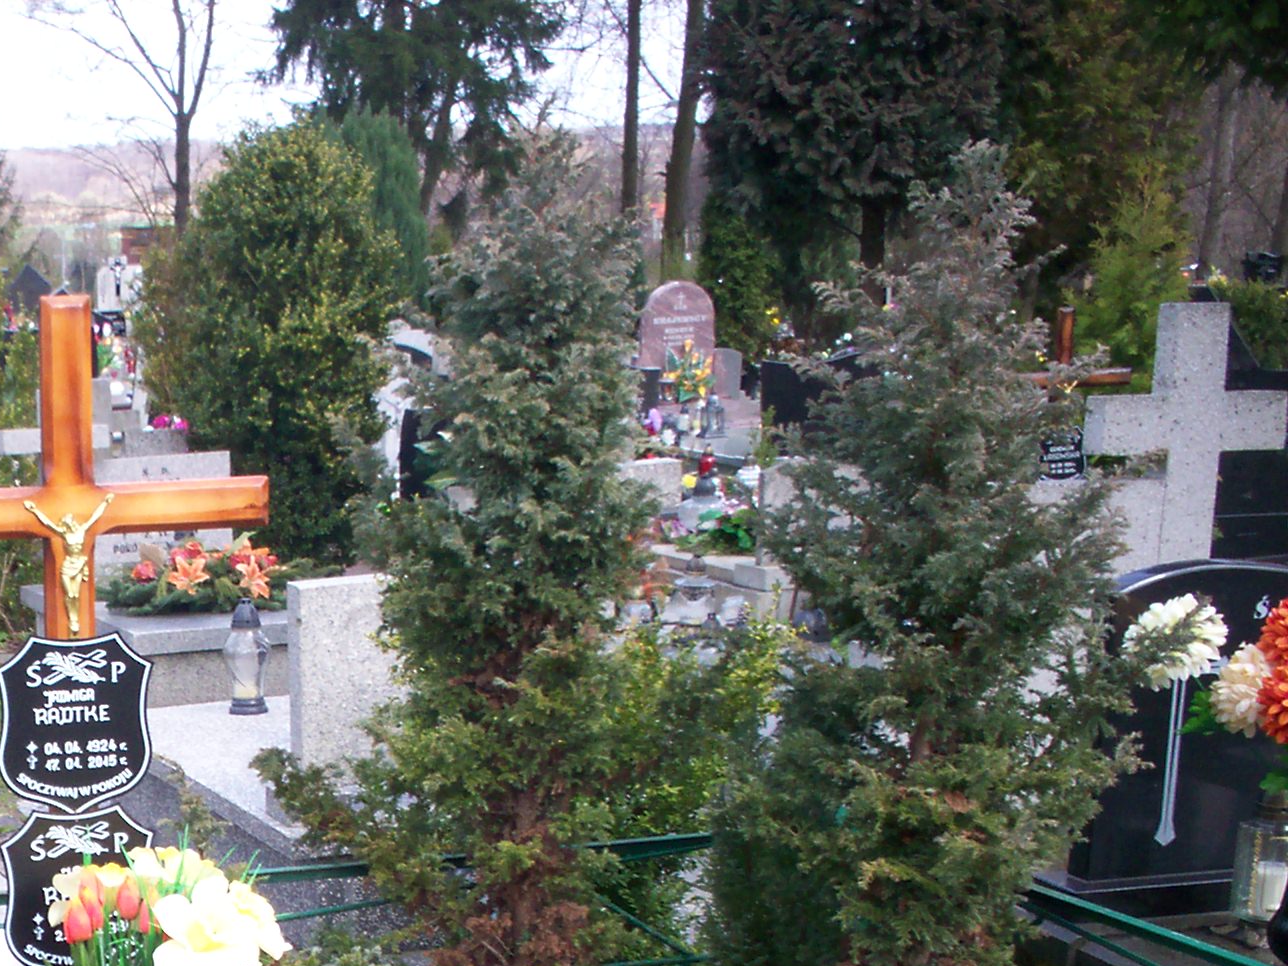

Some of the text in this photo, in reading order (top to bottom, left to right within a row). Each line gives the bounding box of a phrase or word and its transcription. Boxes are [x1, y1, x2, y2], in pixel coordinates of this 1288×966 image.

[110, 661, 127, 683] P
[32, 704, 111, 726] RADTKE
[87, 754, 117, 769] 2015
[113, 832, 129, 853] P
[23, 943, 75, 966] SPOCZYW
